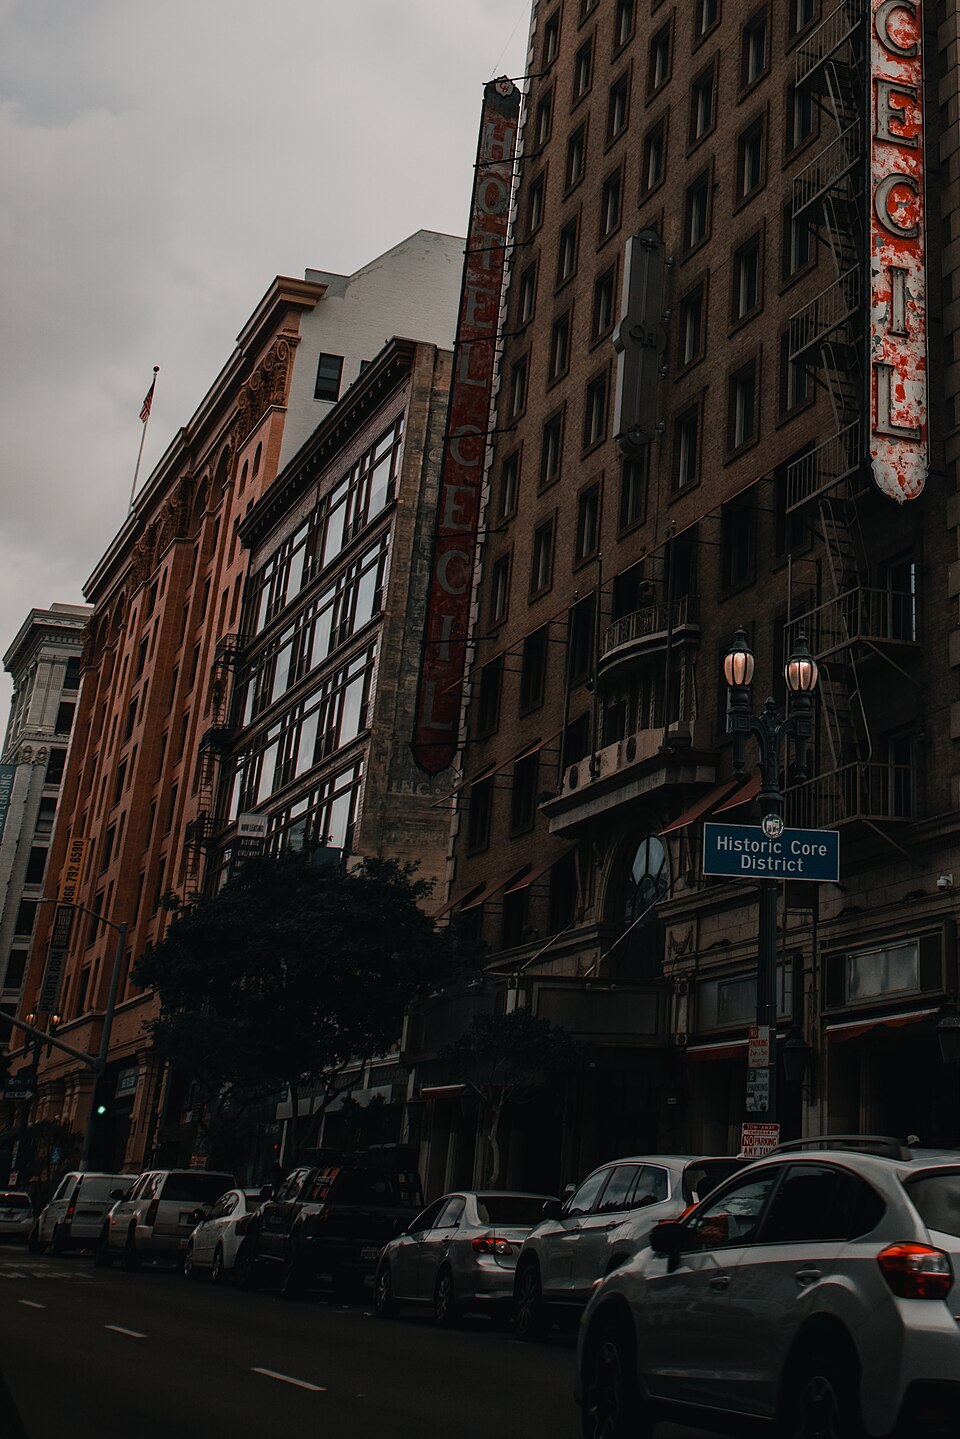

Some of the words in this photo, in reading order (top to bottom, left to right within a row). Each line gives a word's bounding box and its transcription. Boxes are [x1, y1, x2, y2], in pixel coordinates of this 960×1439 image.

[459, 122, 513, 388] HOTEL
[418, 422, 481, 732] CECIL
[717, 835, 782, 854] Historic
[791, 840, 828, 856] Core
[741, 854, 804, 872] District
[743, 1135, 754, 1146] NO
[754, 1137, 777, 1147] PARKING
[743, 1146, 757, 1156] ANY
